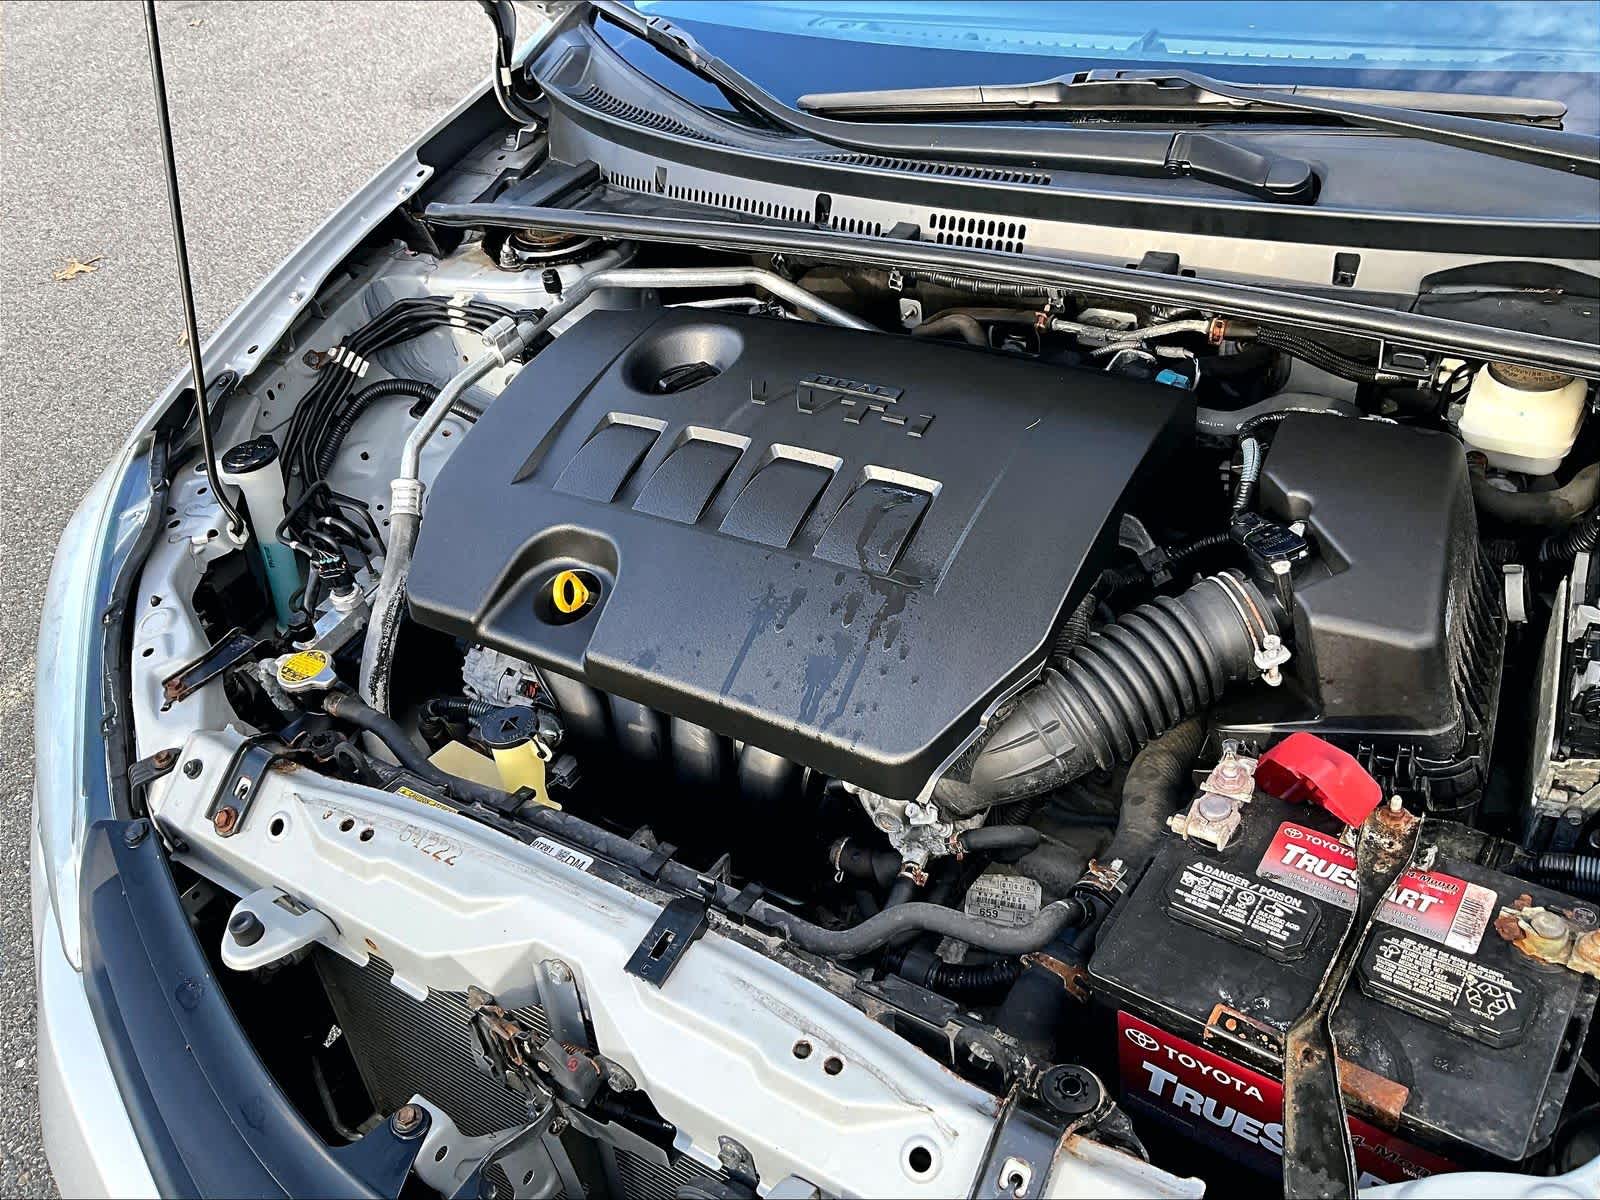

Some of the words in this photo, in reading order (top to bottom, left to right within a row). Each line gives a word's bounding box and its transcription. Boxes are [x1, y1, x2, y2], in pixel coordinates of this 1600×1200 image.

[1305, 833, 1356, 859] TOYOTA
[1203, 864, 1250, 888] DANGER
[1258, 885, 1302, 908] POISON
[980, 908, 998, 918] 659
[1164, 1045, 1264, 1102] TOYOTA
[1142, 1060, 1284, 1155] TRUES
